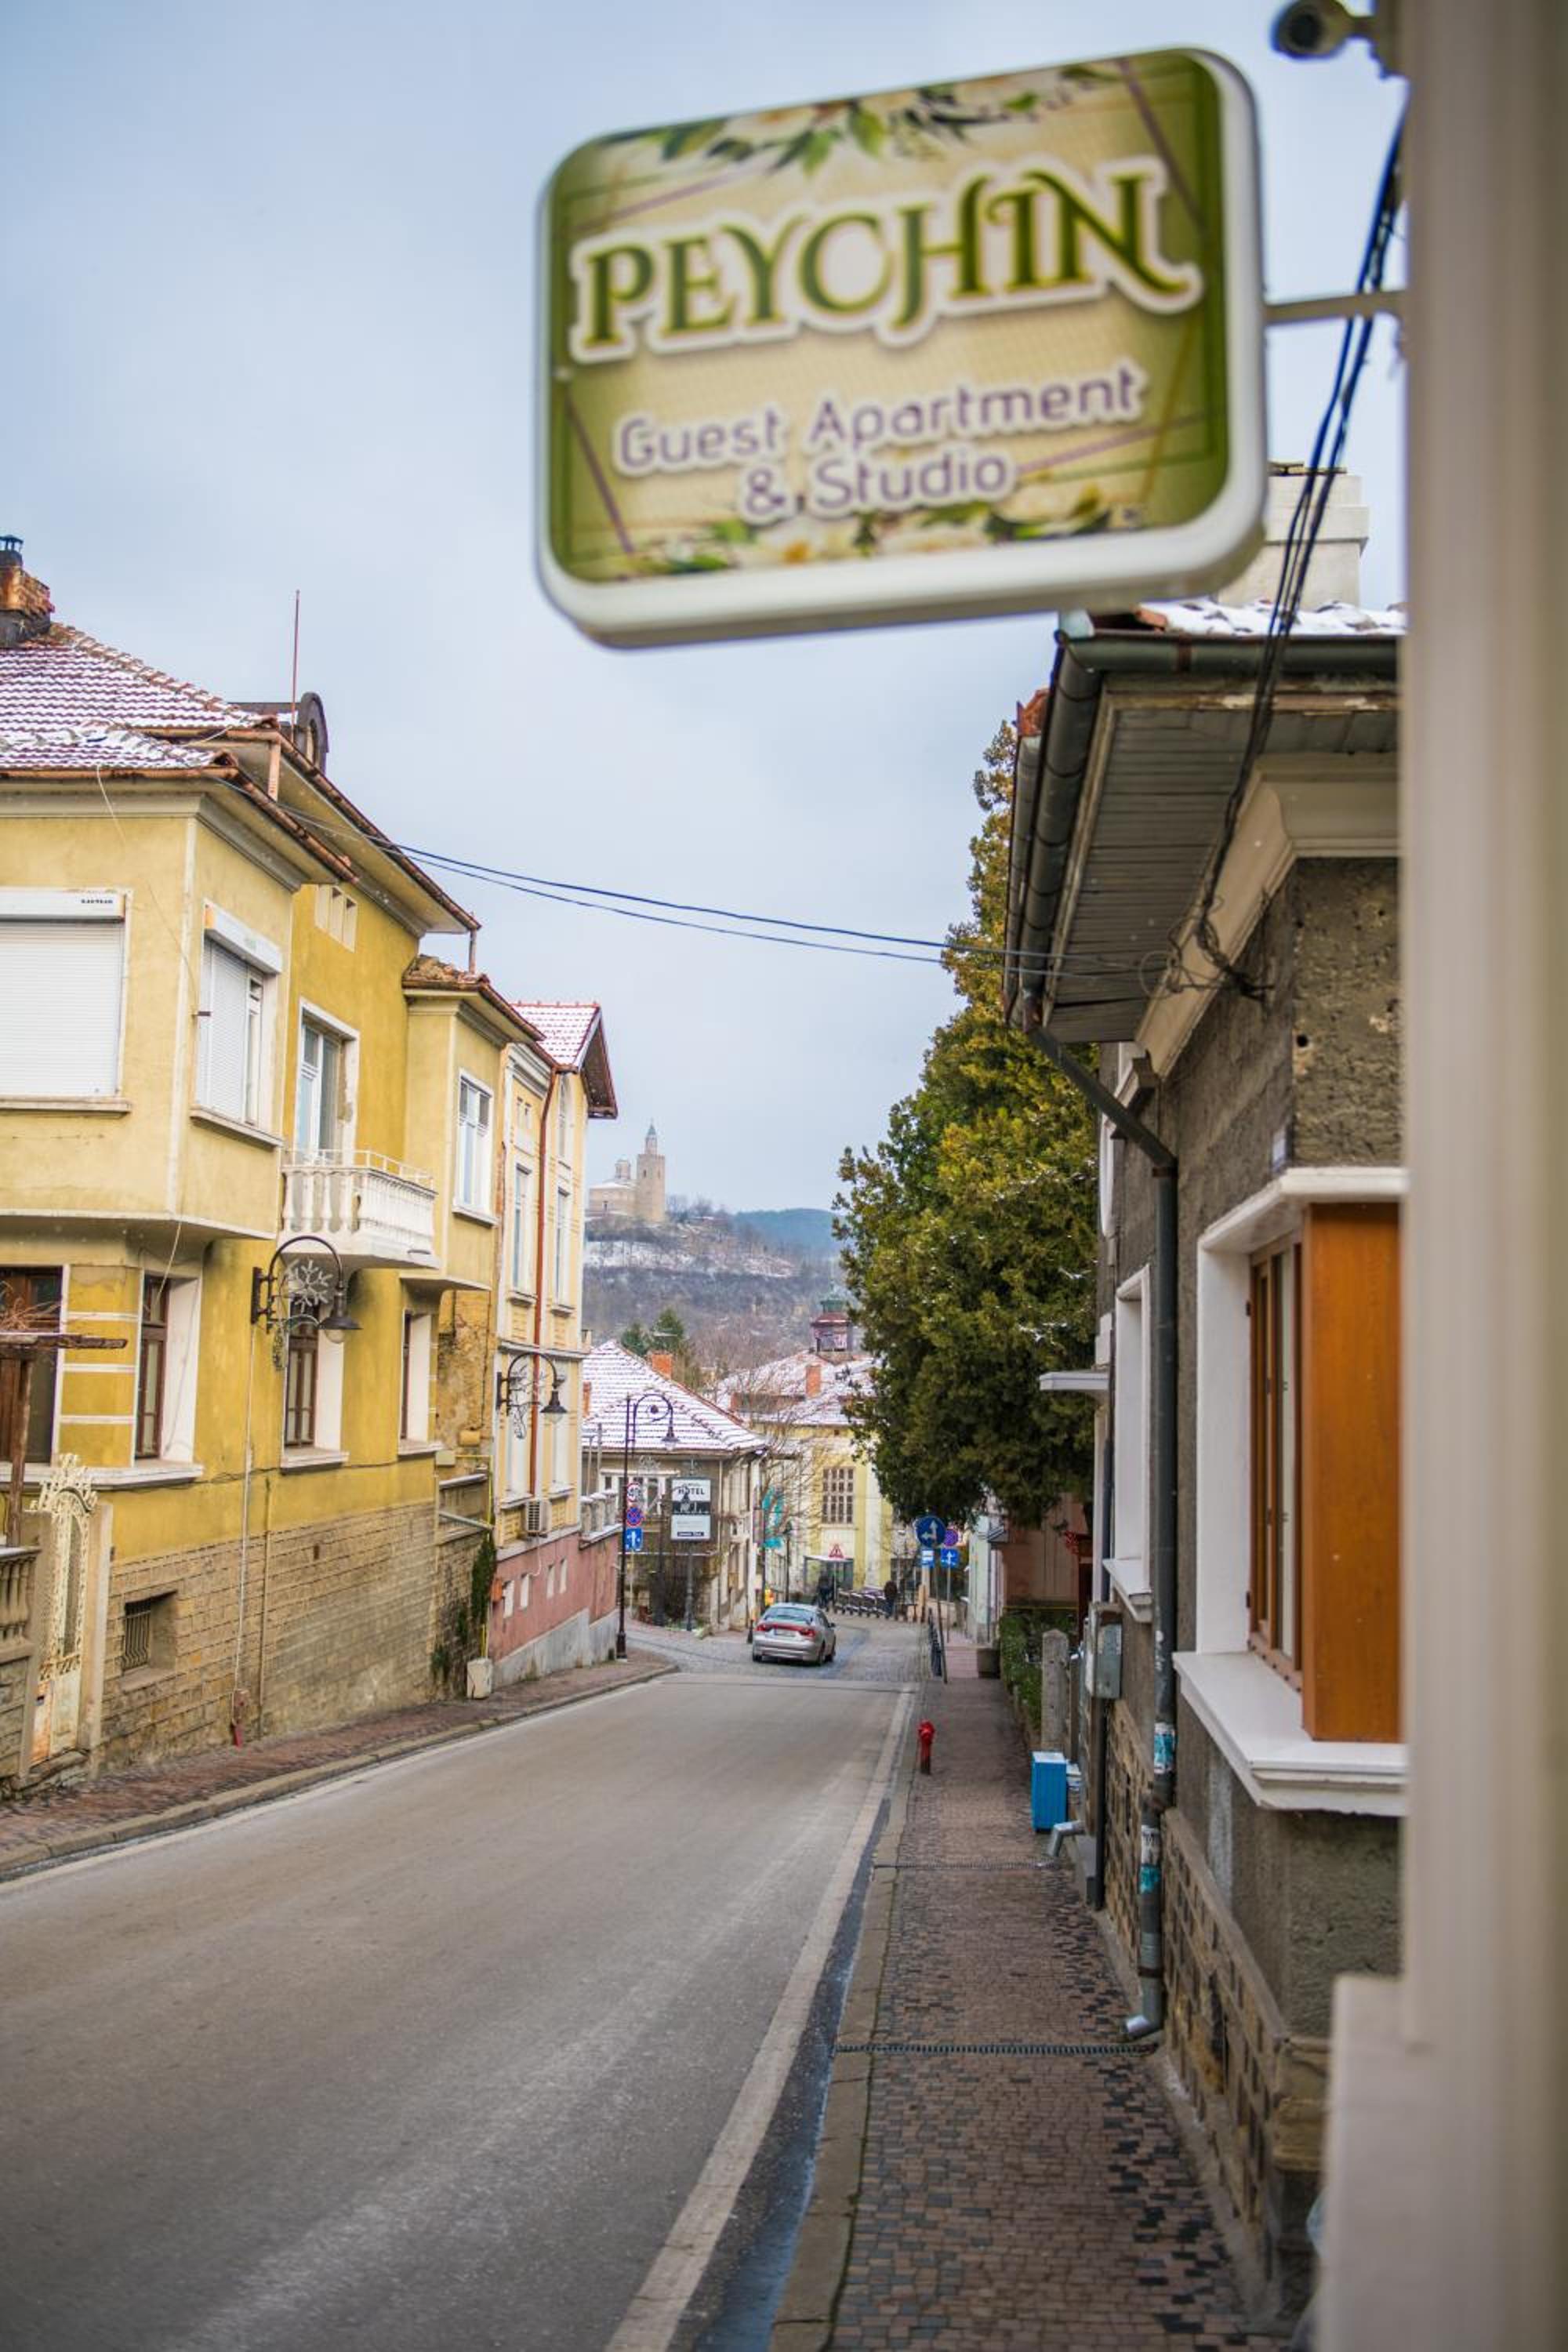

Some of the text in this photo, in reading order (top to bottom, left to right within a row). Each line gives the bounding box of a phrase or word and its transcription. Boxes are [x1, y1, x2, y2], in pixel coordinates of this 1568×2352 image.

[581, 168, 1192, 350] PEYCHIN
[619, 366, 1136, 468] Guest Apartment
[744, 454, 1008, 517] & Studio
